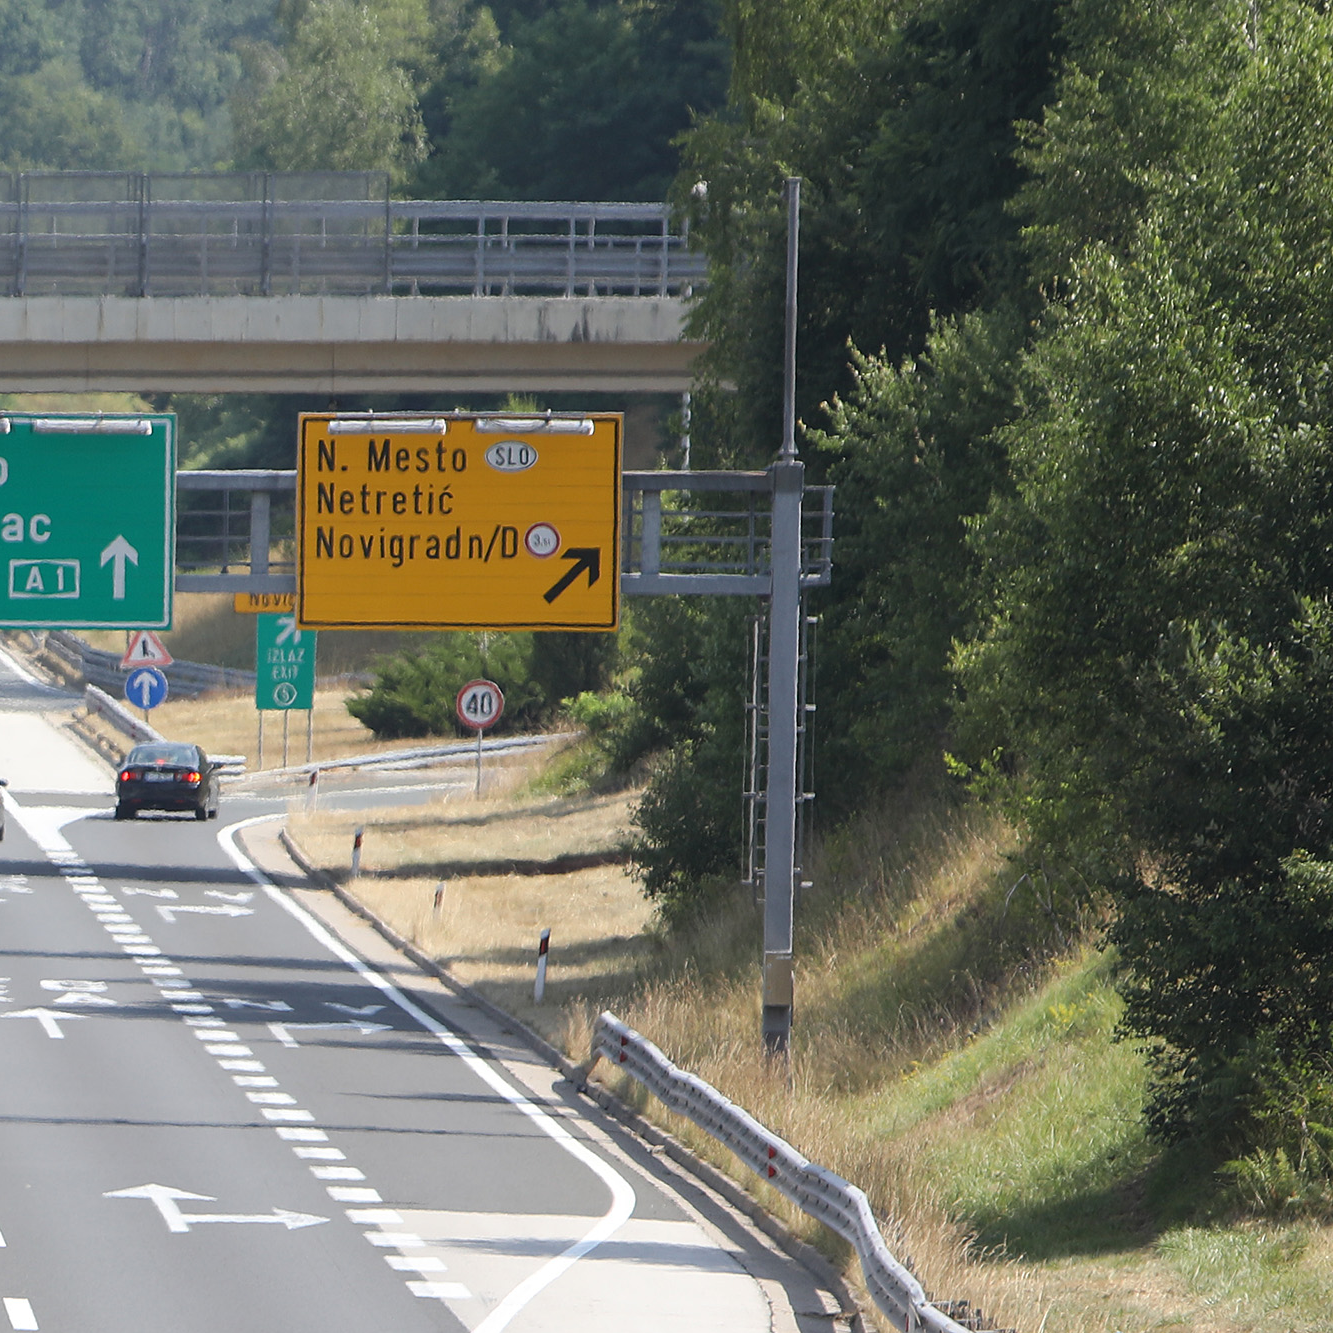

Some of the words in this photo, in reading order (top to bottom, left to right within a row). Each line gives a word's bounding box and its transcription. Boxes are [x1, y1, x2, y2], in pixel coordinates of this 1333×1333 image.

[317, 439, 348, 472] N.
[367, 438, 467, 472] Mesto
[495, 446, 530, 466] SLO
[317, 482, 454, 515] Netretić
[316, 525, 519, 567] Novigradn/D
[25, 567, 44, 591] A
[56, 567, 65, 590] 1
[271, 664, 299, 681] EXIT
[466, 691, 493, 715] 40
